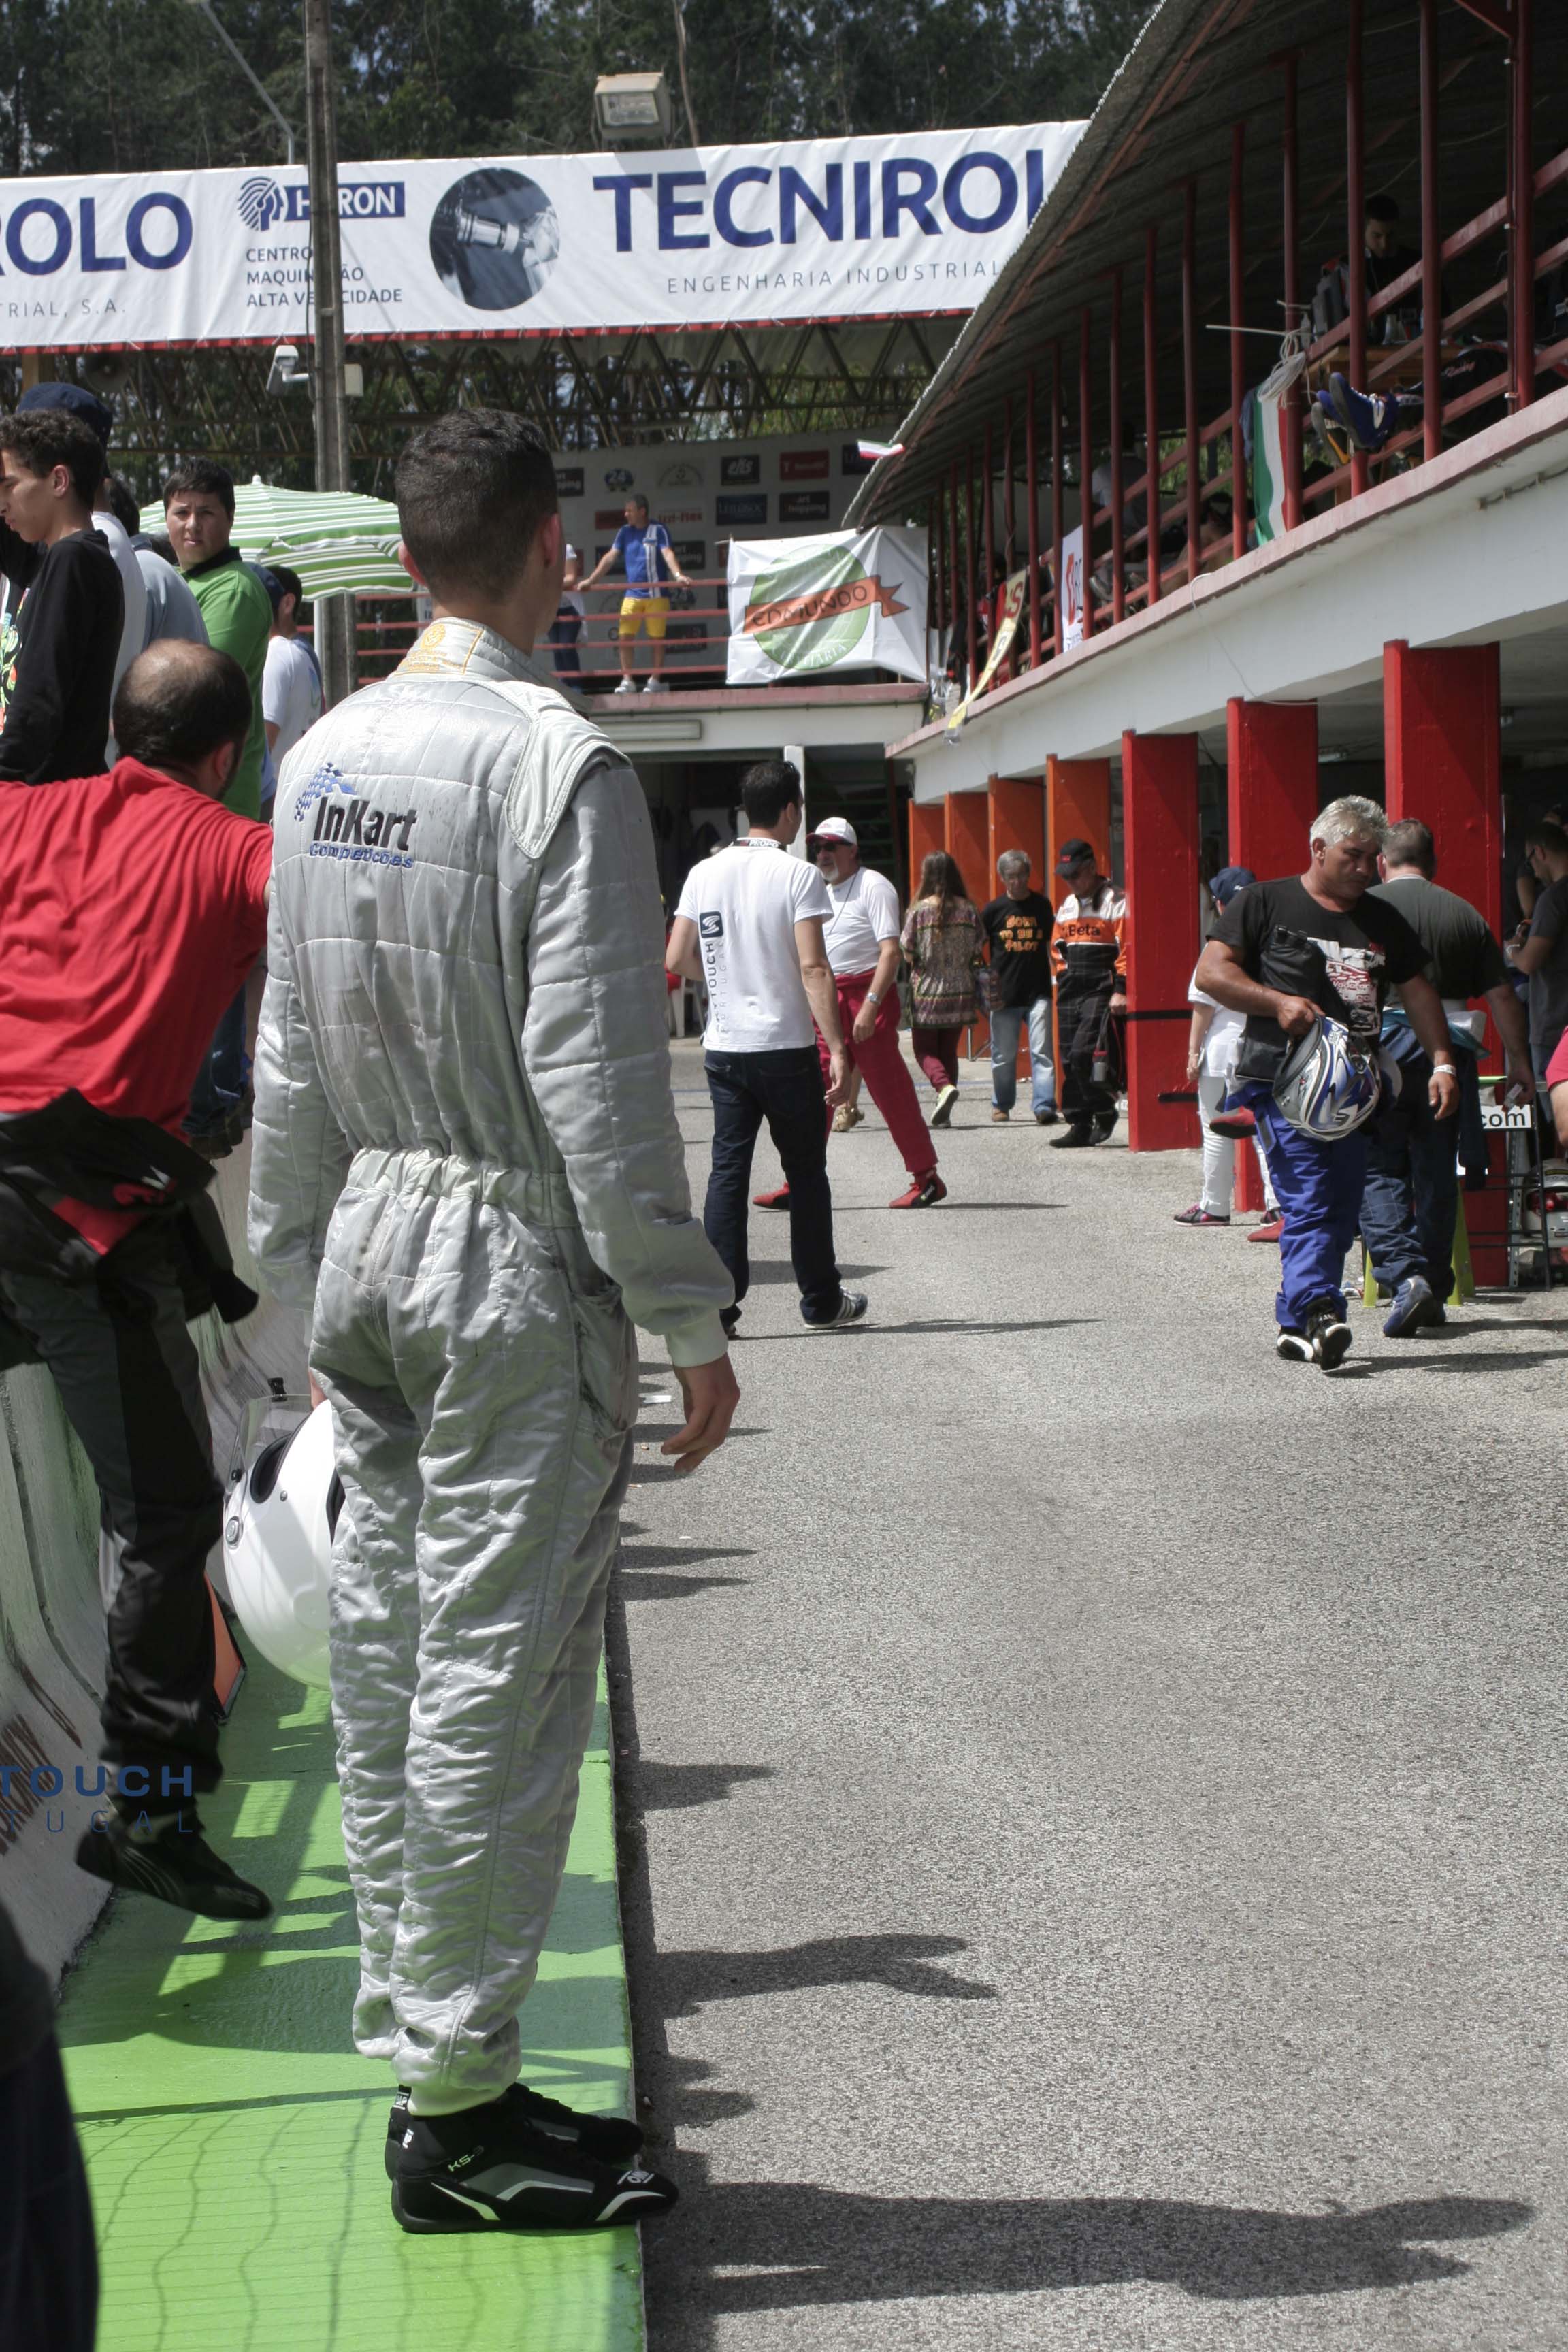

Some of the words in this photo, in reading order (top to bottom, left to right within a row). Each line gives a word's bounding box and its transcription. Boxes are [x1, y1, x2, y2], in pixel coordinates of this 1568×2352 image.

[295, 186, 396, 218] HRON
[0, 191, 193, 276] OLO
[246, 247, 314, 262] CENTRO
[246, 263, 364, 287] MAQUINÃO
[668, 269, 832, 294] ENGENHARIA
[846, 259, 1000, 284] INDUSTRIAL
[0, 301, 67, 319] RIAL,
[81, 298, 127, 314] S.A.
[246, 292, 289, 308] ALTA
[293, 288, 403, 306] VECIDADE
[312, 796, 418, 851] InKart
[1068, 922, 1101, 937] Beta
